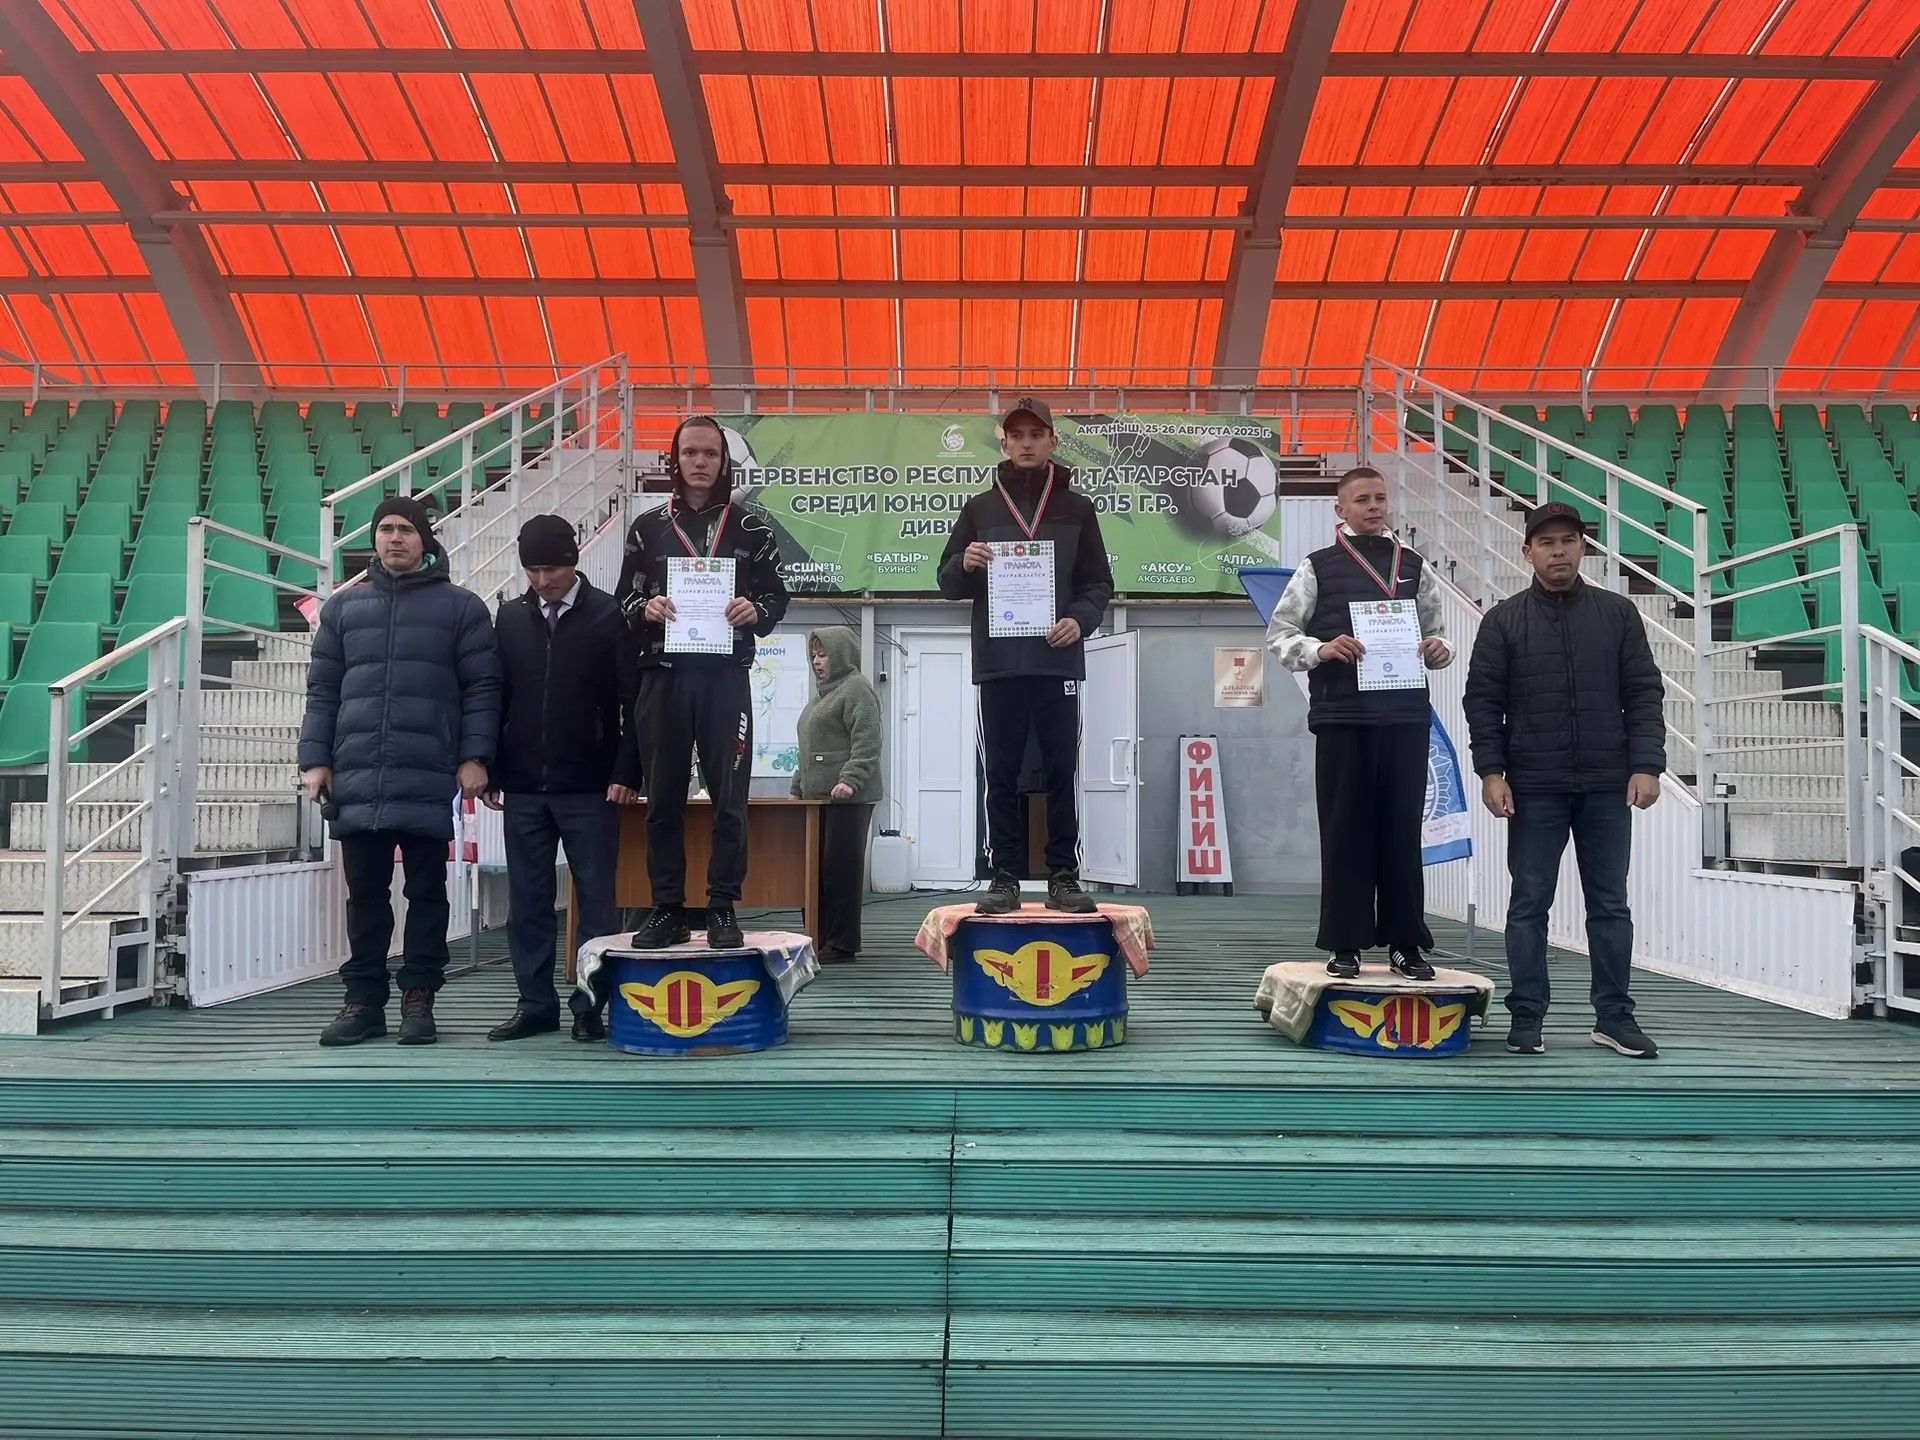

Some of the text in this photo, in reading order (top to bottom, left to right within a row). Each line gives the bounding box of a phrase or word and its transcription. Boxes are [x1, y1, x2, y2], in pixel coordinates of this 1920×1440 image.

[1077, 424, 1142, 435] АКТАНЫШ,
[1145, 424, 1175, 435] 25-26
[1178, 425, 1231, 437] АВГУСТА
[1233, 426, 1261, 438] 2025
[731, 466, 898, 487] ПЕРВЕНСТВО
[1089, 466, 1238, 488] ТАТАРСТАН
[790, 493, 1178, 517] СРЕДИ ЮНОШ 015 Г.Р.
[866, 553, 929, 563] «БАТЫР»
[1216, 553, 1264, 566] «АЛГА»
[878, 566, 918, 574] БУИНСК
[1141, 563, 1192, 573] «АКСУ»
[1220, 565, 1239, 575] ТЮЛ
[1137, 576, 1195, 584] АКСУБАЕВО
[1187, 740, 1222, 874] ФИНИШ
